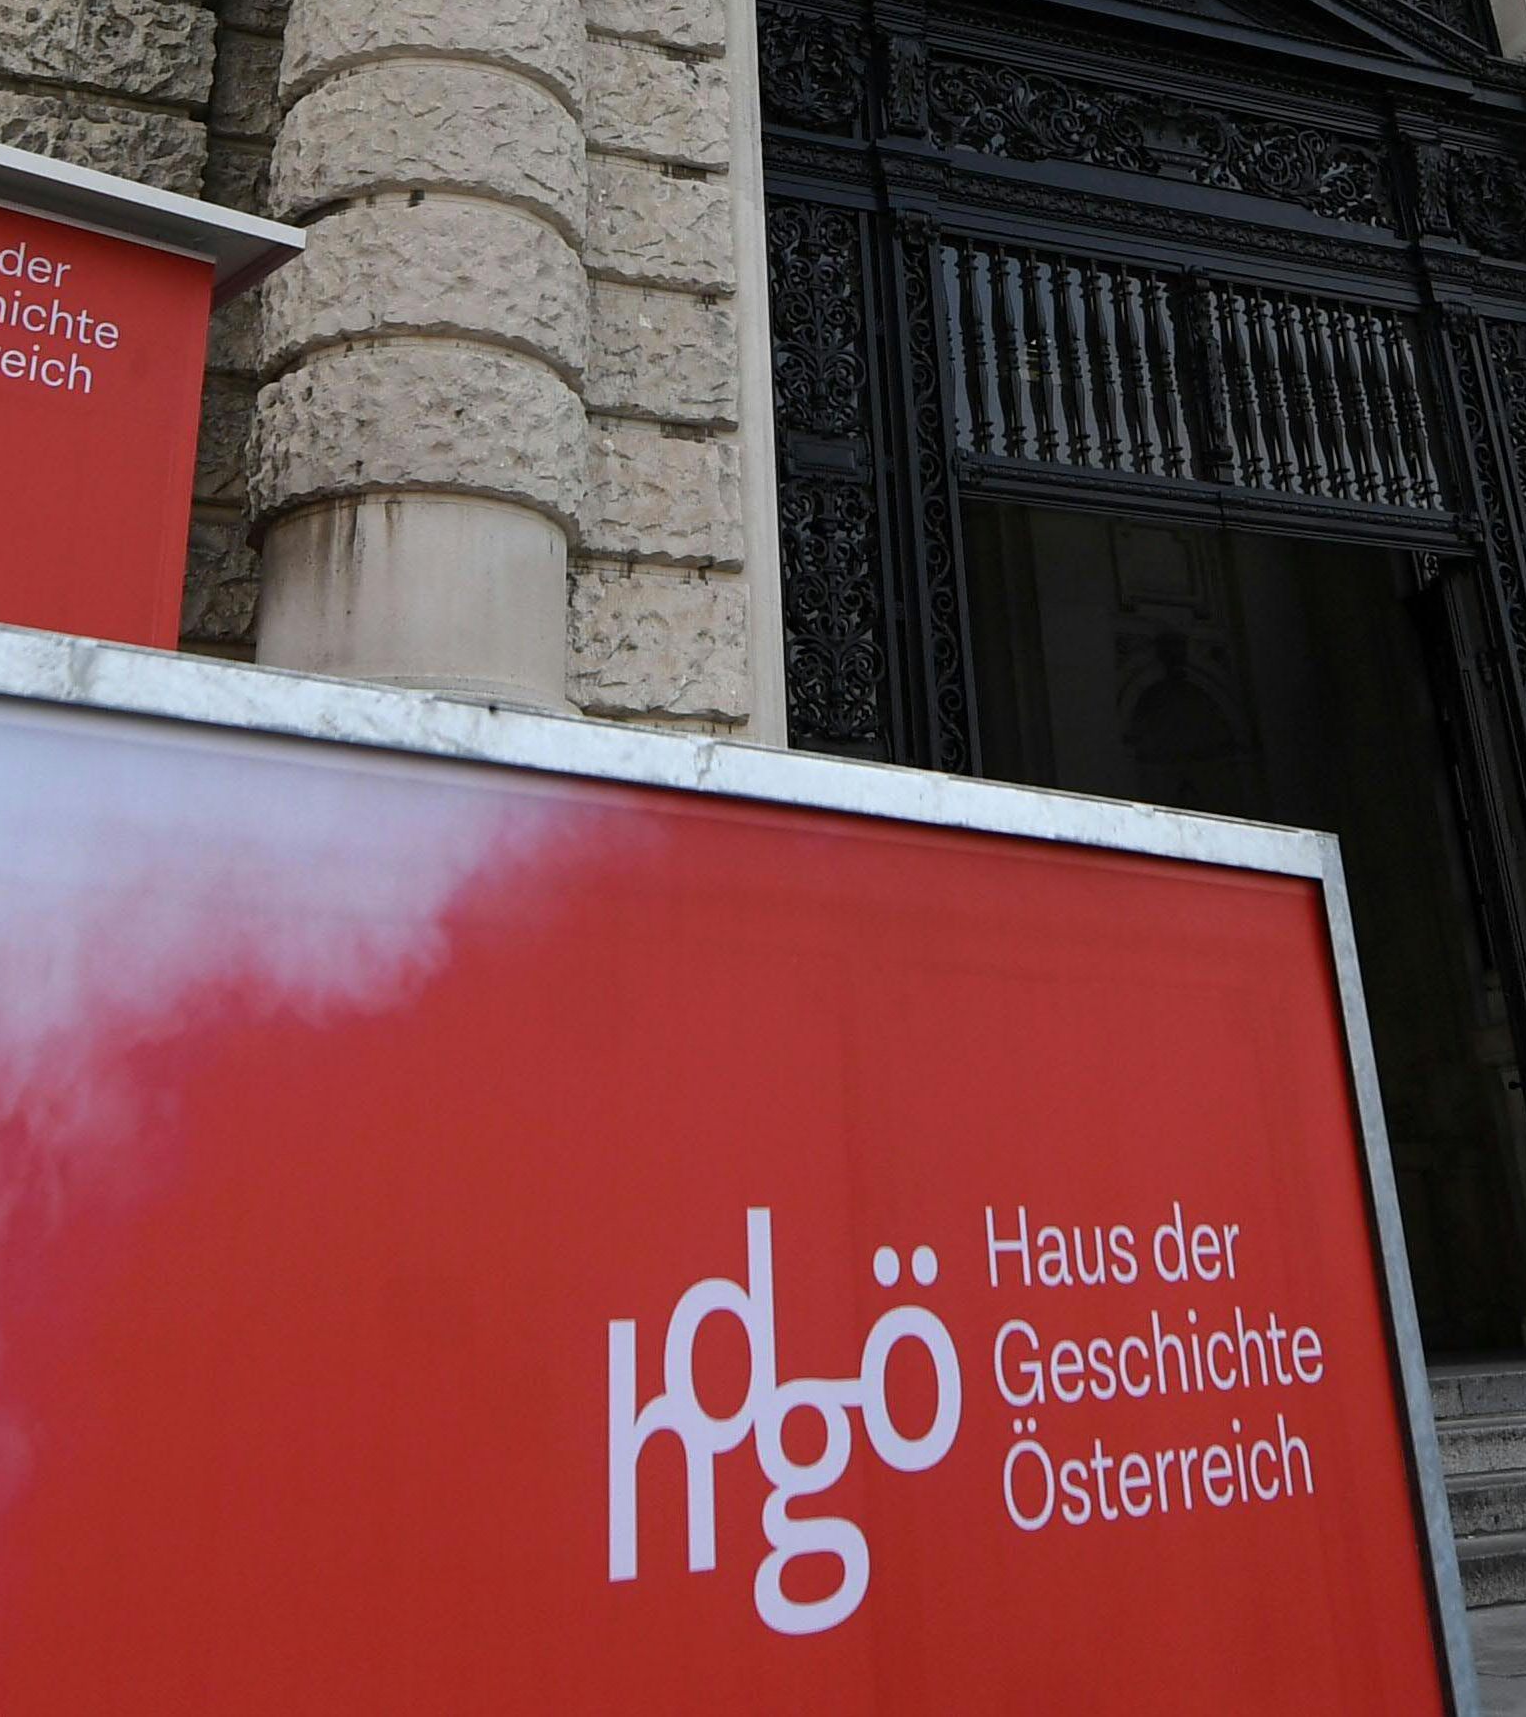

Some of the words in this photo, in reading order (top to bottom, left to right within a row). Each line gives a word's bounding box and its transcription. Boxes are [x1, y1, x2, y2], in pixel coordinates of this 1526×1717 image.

[983, 1205, 1139, 1288] Haus
[1152, 1200, 1240, 1282] der
[993, 1307, 1324, 1408] Geschichte
[1002, 1413, 1315, 1532] Österreich
